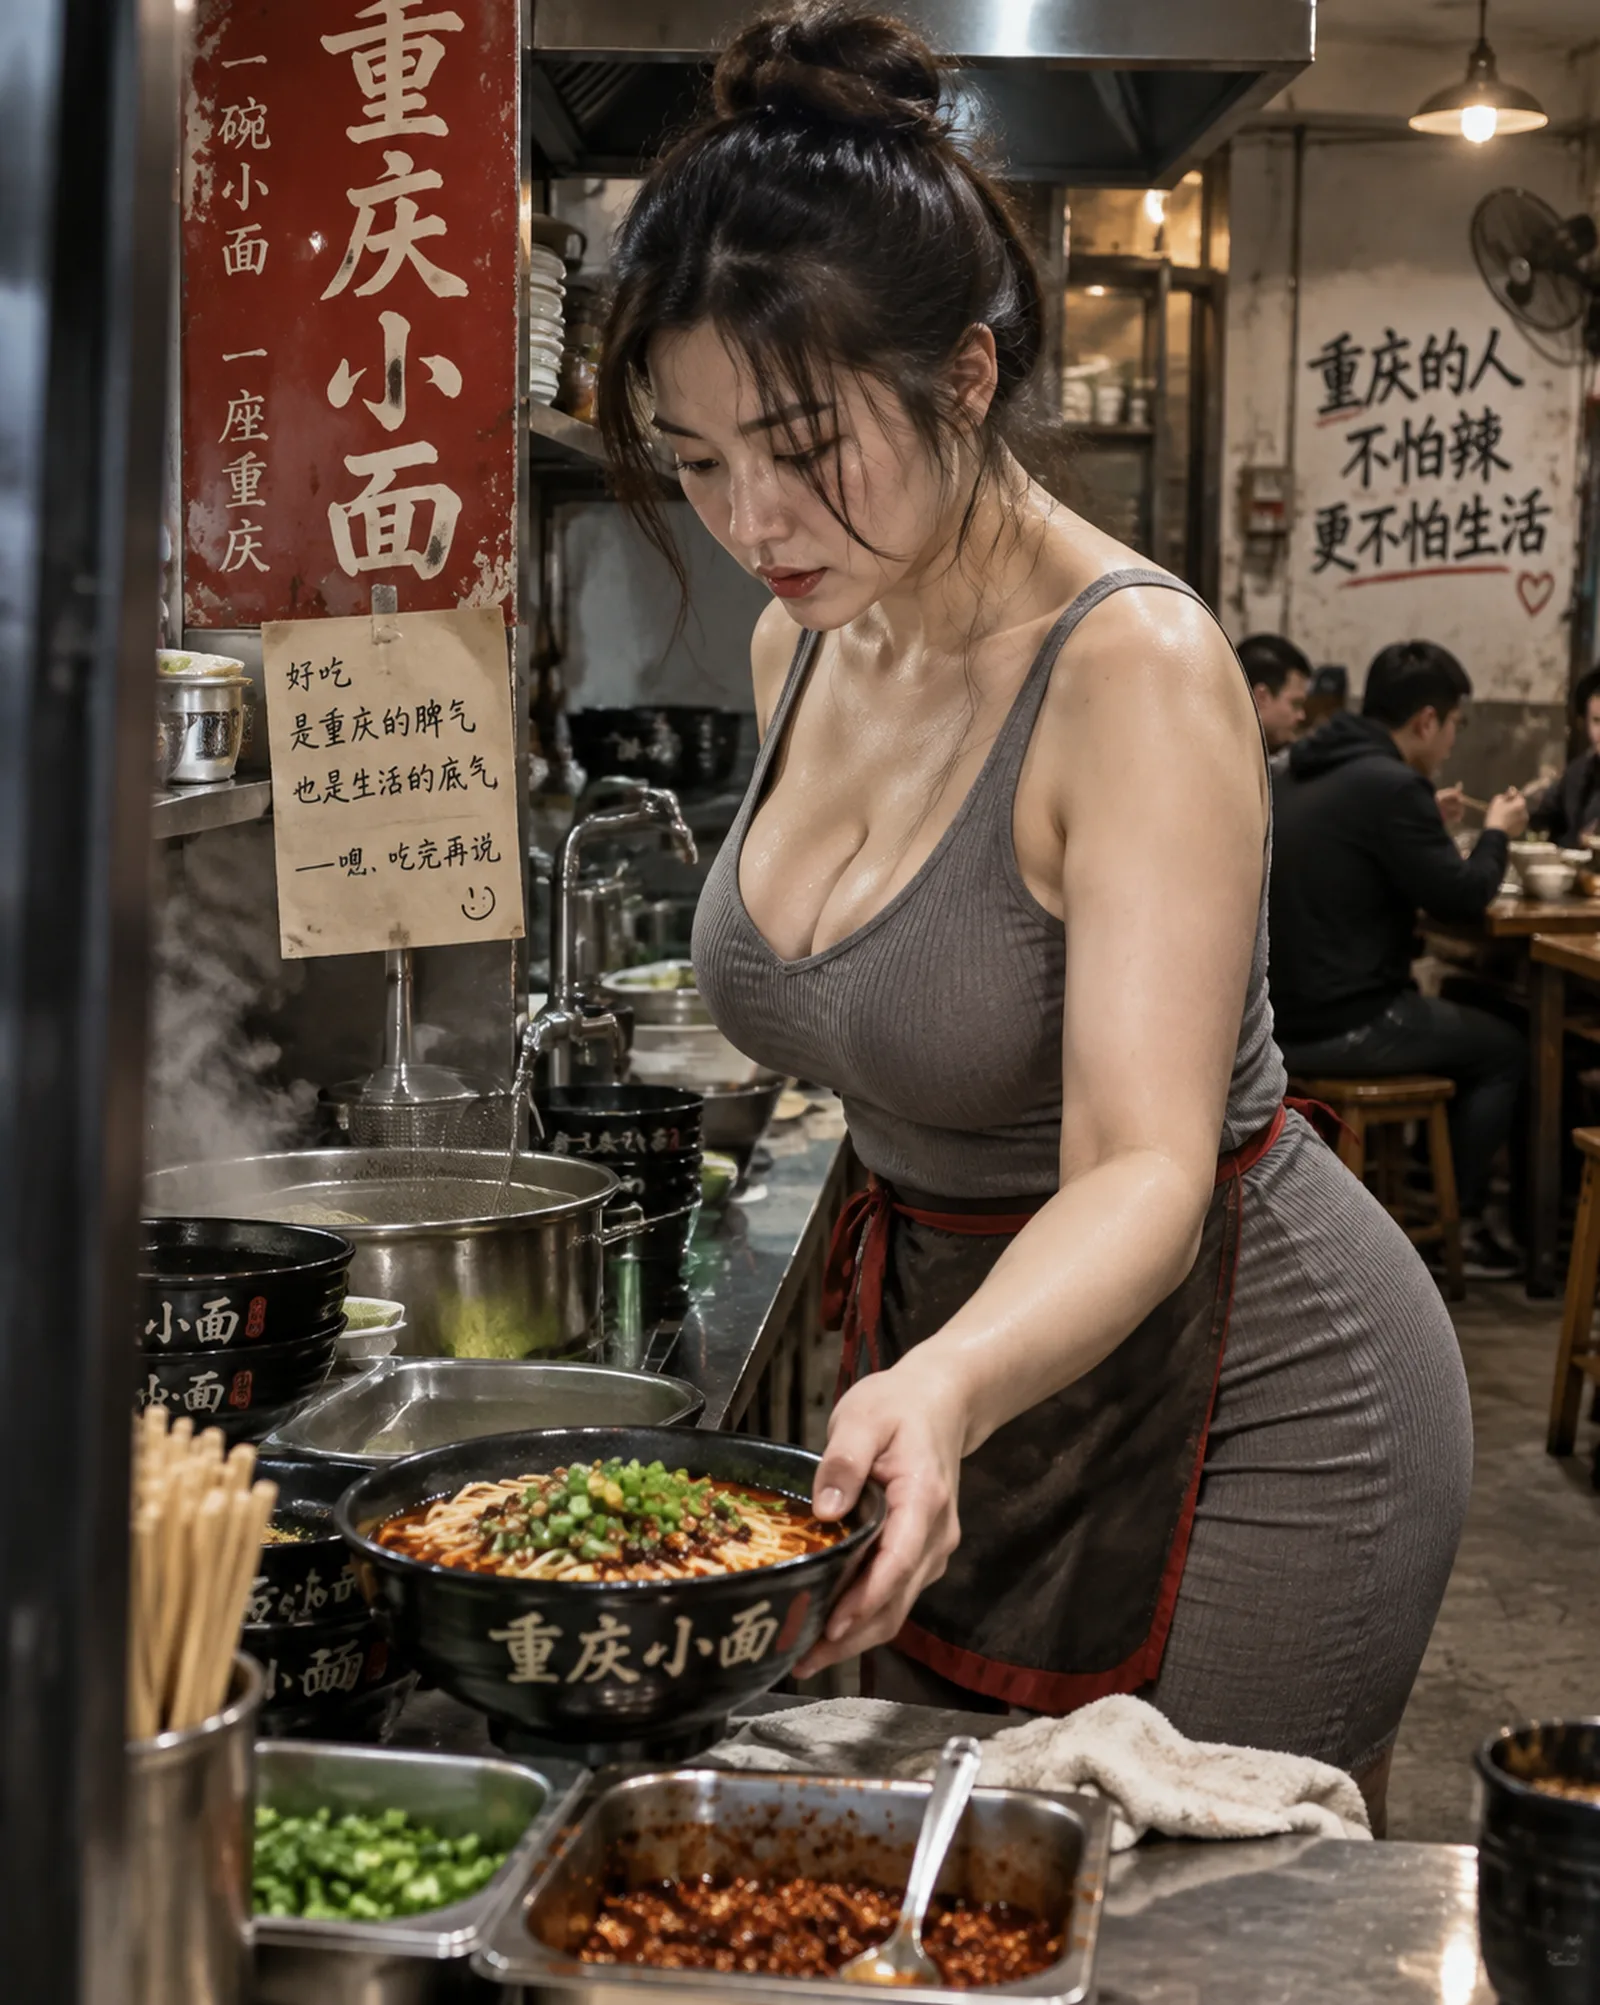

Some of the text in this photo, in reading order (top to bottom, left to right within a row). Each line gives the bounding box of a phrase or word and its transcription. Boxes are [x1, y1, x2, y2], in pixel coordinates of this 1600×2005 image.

[217, 54, 271, 572] 一碗小面 一座重庆
[320, 0, 469, 580] 重庆小面
[1307, 327, 1525, 415] 重庆的人
[1341, 406, 1513, 489] 不怕辣
[1311, 488, 1552, 574] 更不怕生活
[286, 657, 352, 692] 好吃
[290, 699, 476, 751] 是重庆的脾气
[292, 755, 499, 804] 也是生活的底气
[145, 1296, 239, 1344] 小面
[488, 1601, 779, 1684] 重庆小面
